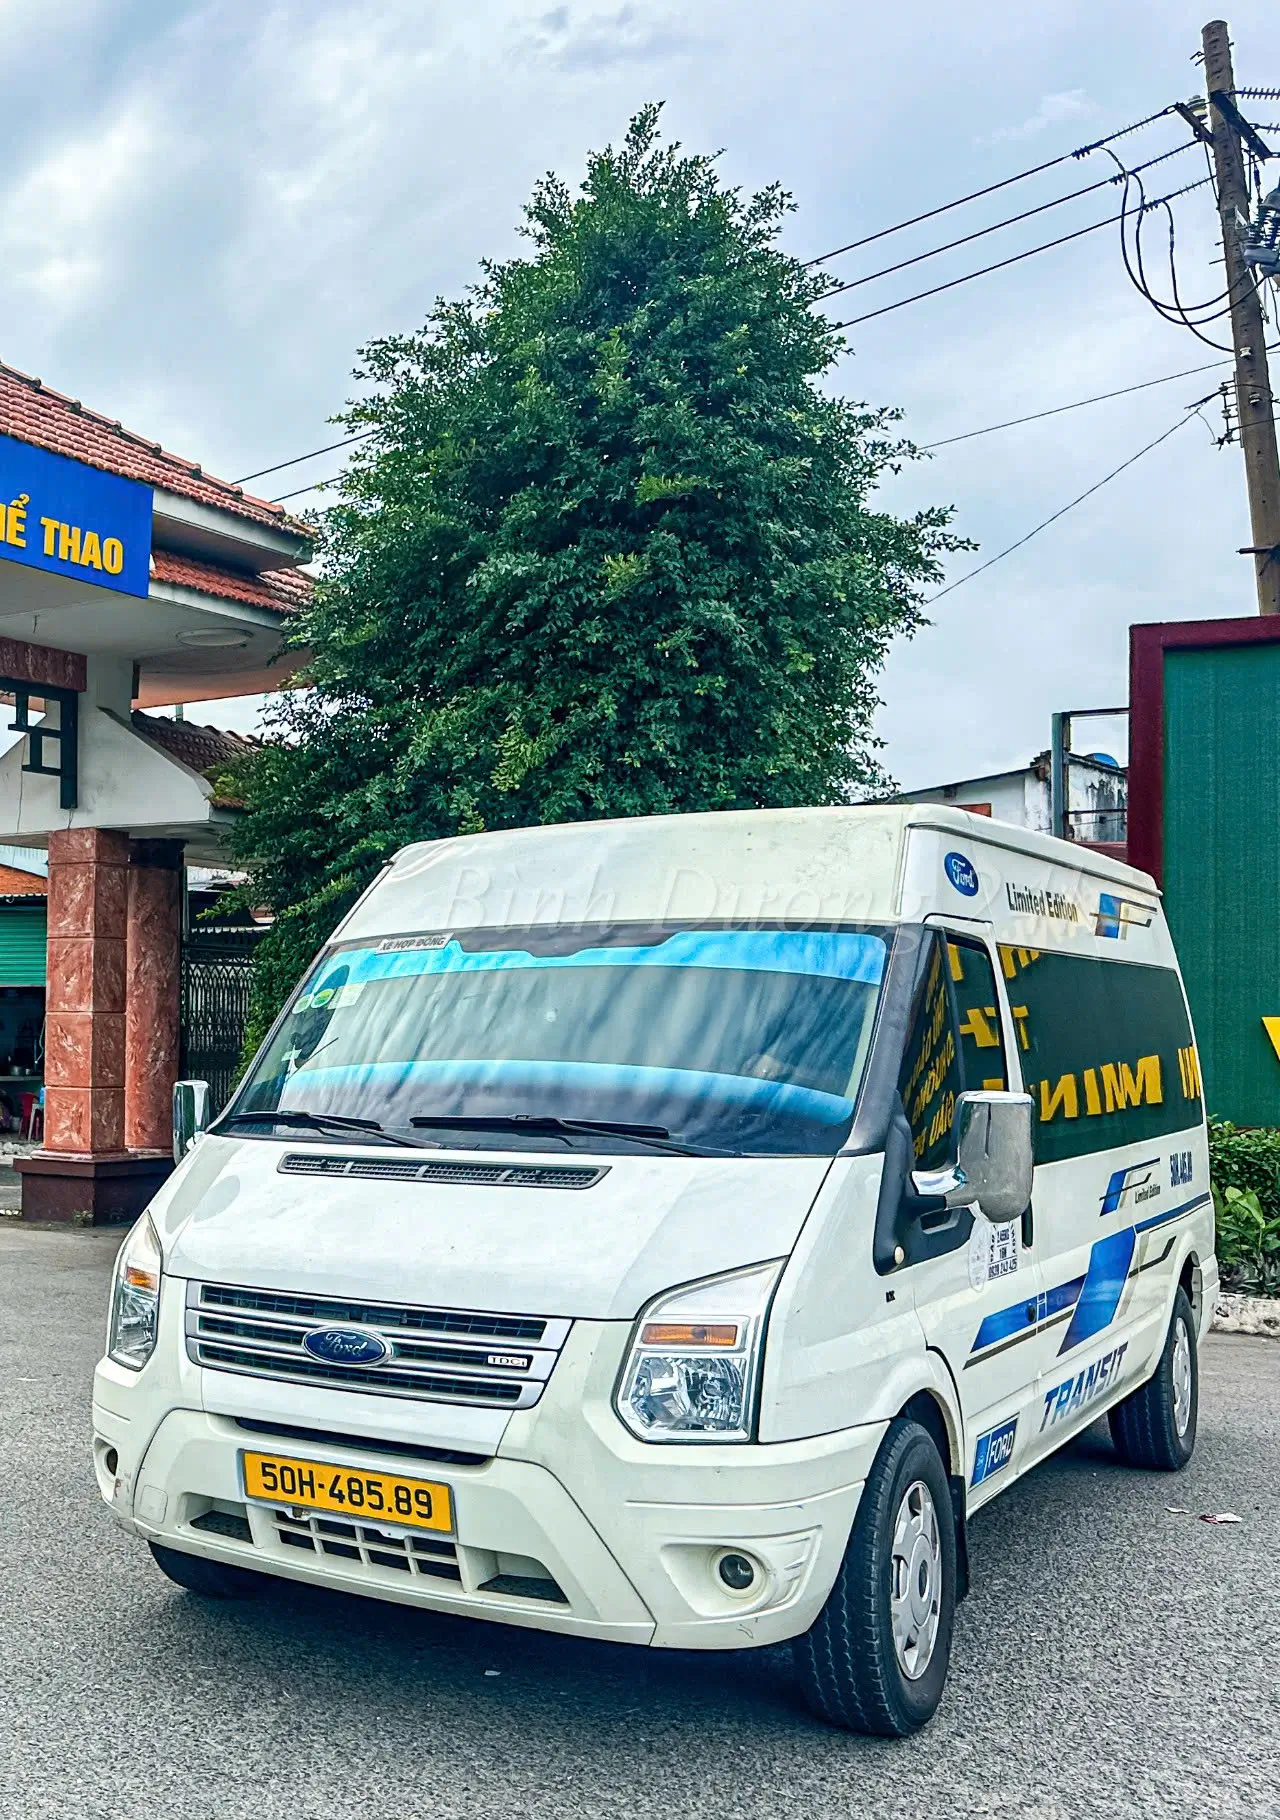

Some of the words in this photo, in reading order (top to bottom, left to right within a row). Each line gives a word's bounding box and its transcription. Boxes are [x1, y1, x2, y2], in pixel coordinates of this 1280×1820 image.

[40, 515, 125, 575] THAO
[950, 857, 975, 889] Ford
[1005, 882, 1045, 914] Limited
[1046, 891, 1080, 923] Edition
[322, 1331, 368, 1358] Ford
[489, 1355, 528, 1368] TDCi
[1039, 1341, 1129, 1433] TRANSIT
[987, 1430, 1015, 1469] FORD
[261, 1461, 433, 1520] 50H-485.89
